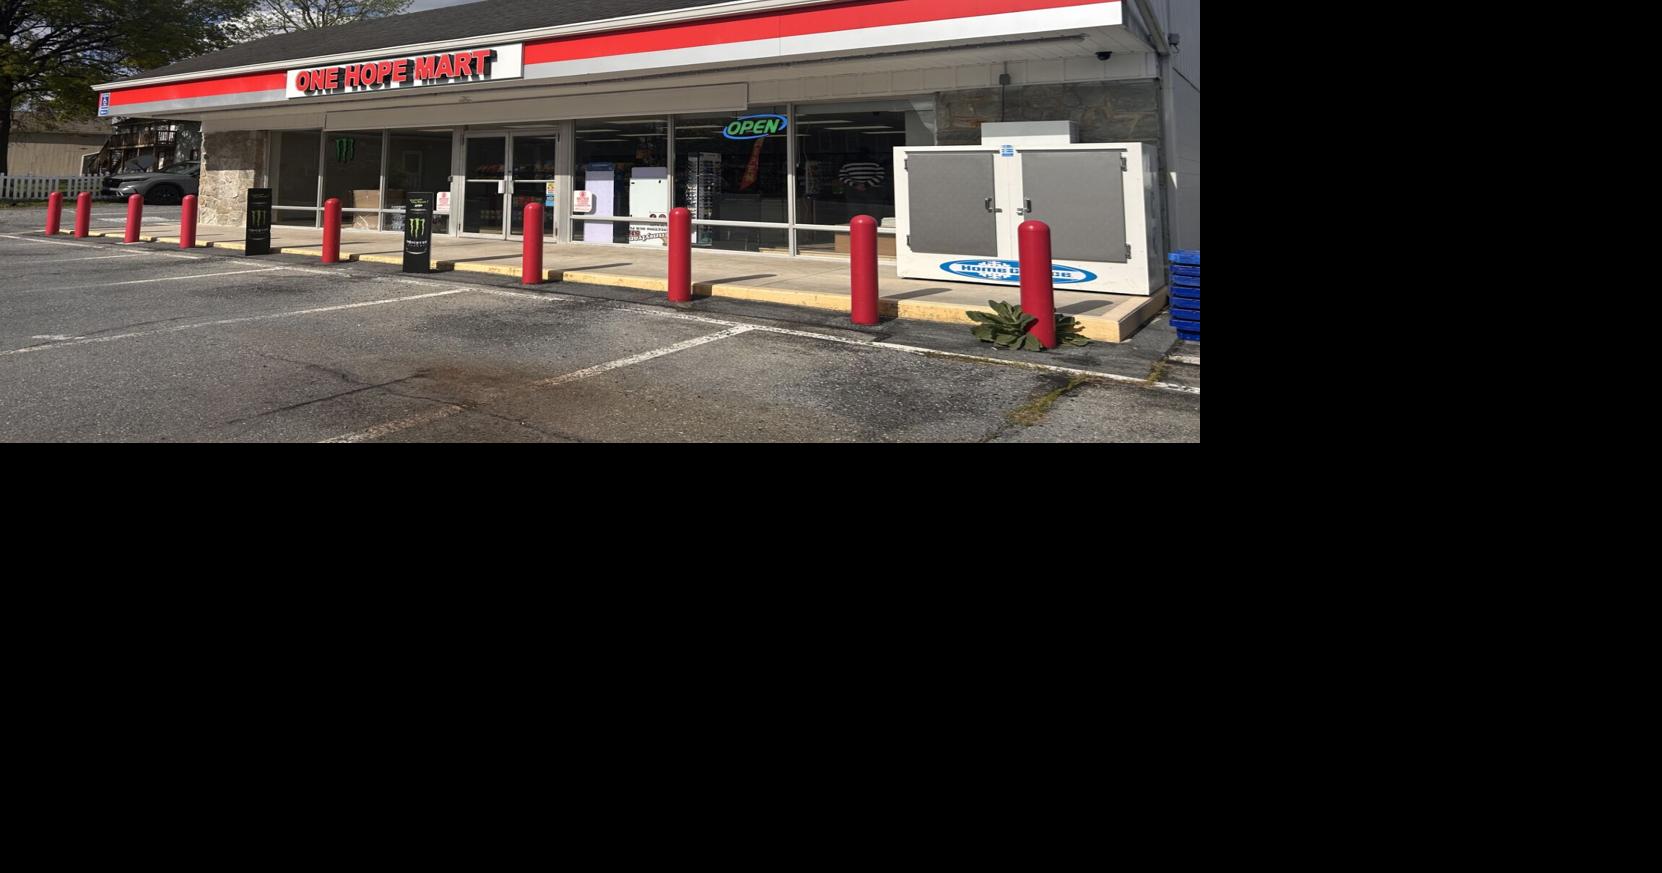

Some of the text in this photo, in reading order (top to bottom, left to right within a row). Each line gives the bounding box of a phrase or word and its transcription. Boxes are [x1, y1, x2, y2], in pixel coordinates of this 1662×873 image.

[295, 49, 491, 92] ONE HOPE MART
[727, 118, 780, 135] OPEN
